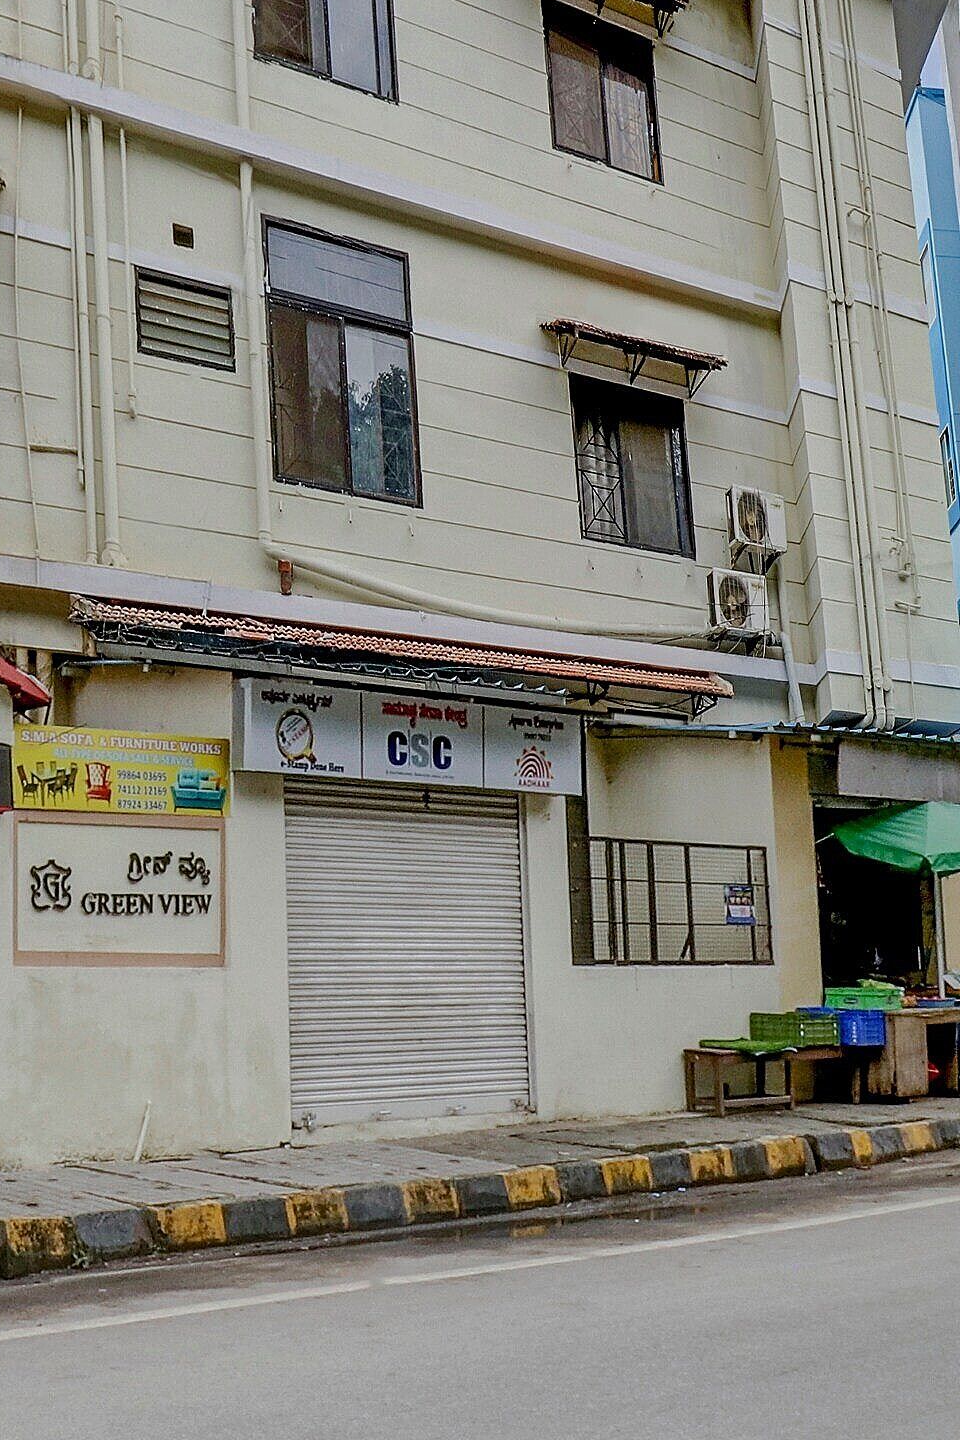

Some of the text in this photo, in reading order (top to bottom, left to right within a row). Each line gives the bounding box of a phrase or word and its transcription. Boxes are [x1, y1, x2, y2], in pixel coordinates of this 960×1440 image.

[61, 733, 94, 746] SOFA
[110, 738, 177, 752] FURNITURE
[179, 741, 222, 755] WORKS
[387, 731, 452, 770] CSC
[81, 893, 213, 916] GREEN VIEW
